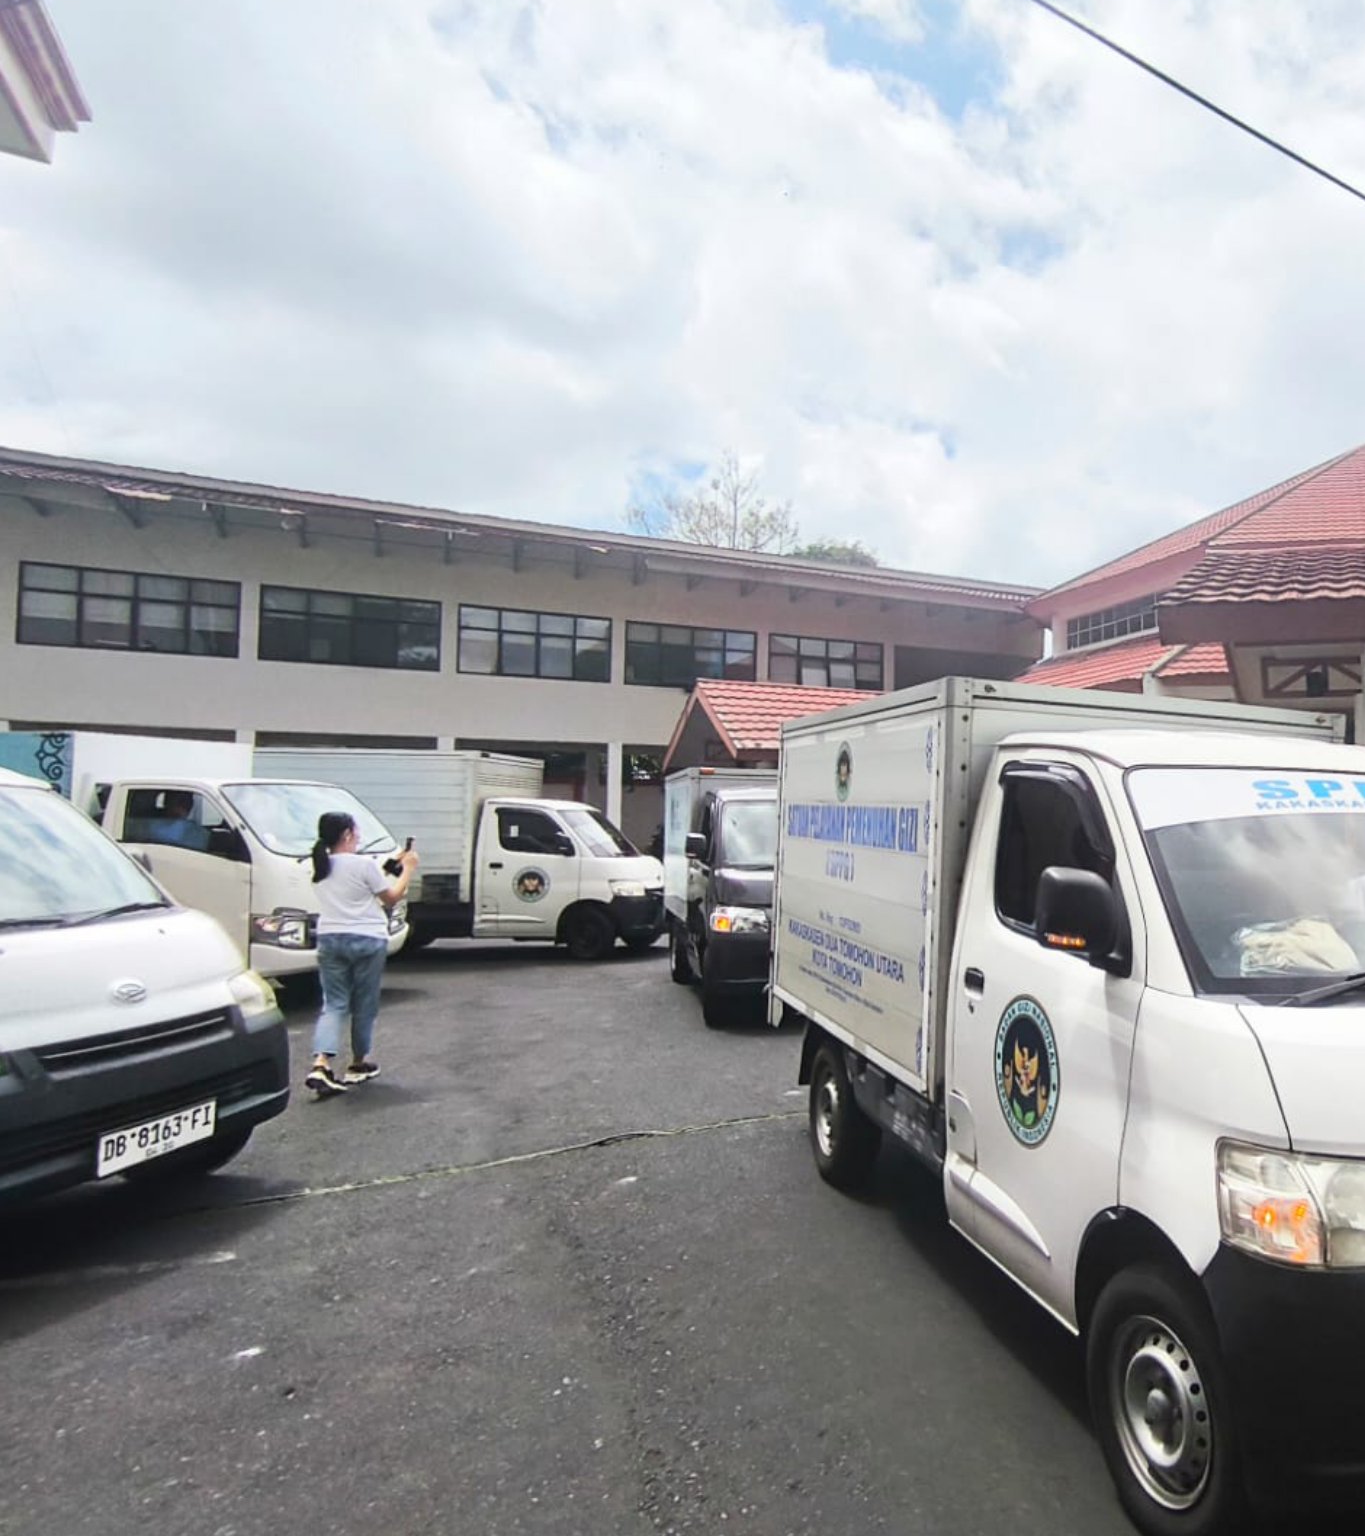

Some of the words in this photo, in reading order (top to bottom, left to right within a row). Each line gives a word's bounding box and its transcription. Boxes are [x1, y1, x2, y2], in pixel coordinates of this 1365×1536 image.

[899, 806, 918, 853] GIZI
[829, 955, 862, 988] TOMOHON
[840, 938, 875, 970] TOMOHON
[876, 952, 904, 984] UTARA
[103, 1134, 127, 1162] DB
[138, 1115, 182, 1149] 8163
[191, 1105, 211, 1130] FI
